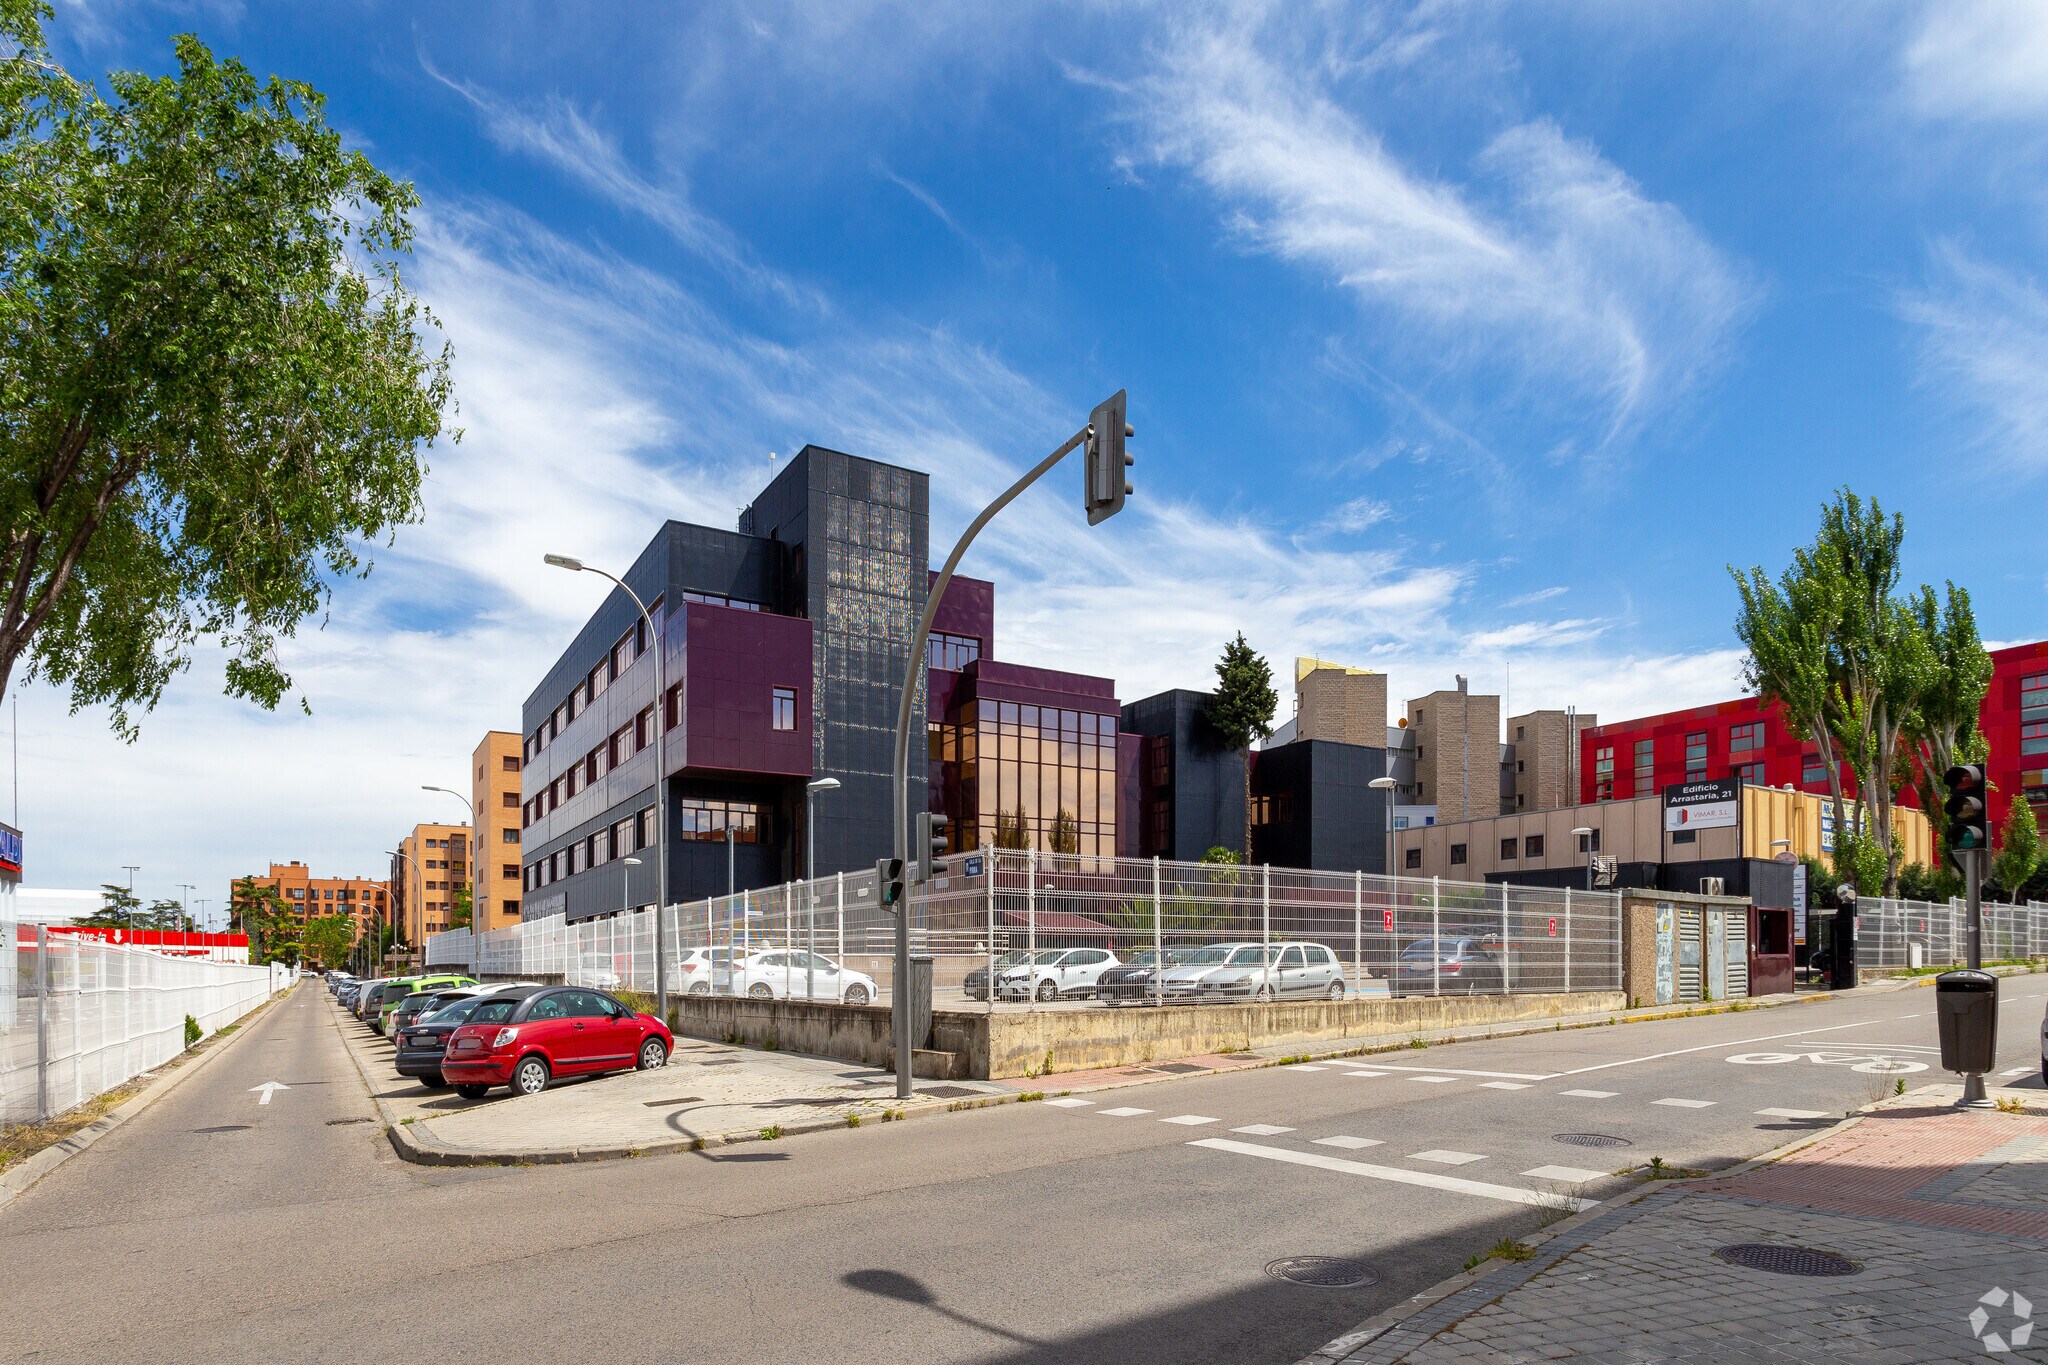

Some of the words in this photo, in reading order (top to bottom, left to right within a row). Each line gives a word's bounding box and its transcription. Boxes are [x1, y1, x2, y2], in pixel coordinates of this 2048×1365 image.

[1682, 783, 1719, 794] Edificio
[1670, 792, 1720, 804] Arrastaria,
[1721, 790, 1732, 798] 21
